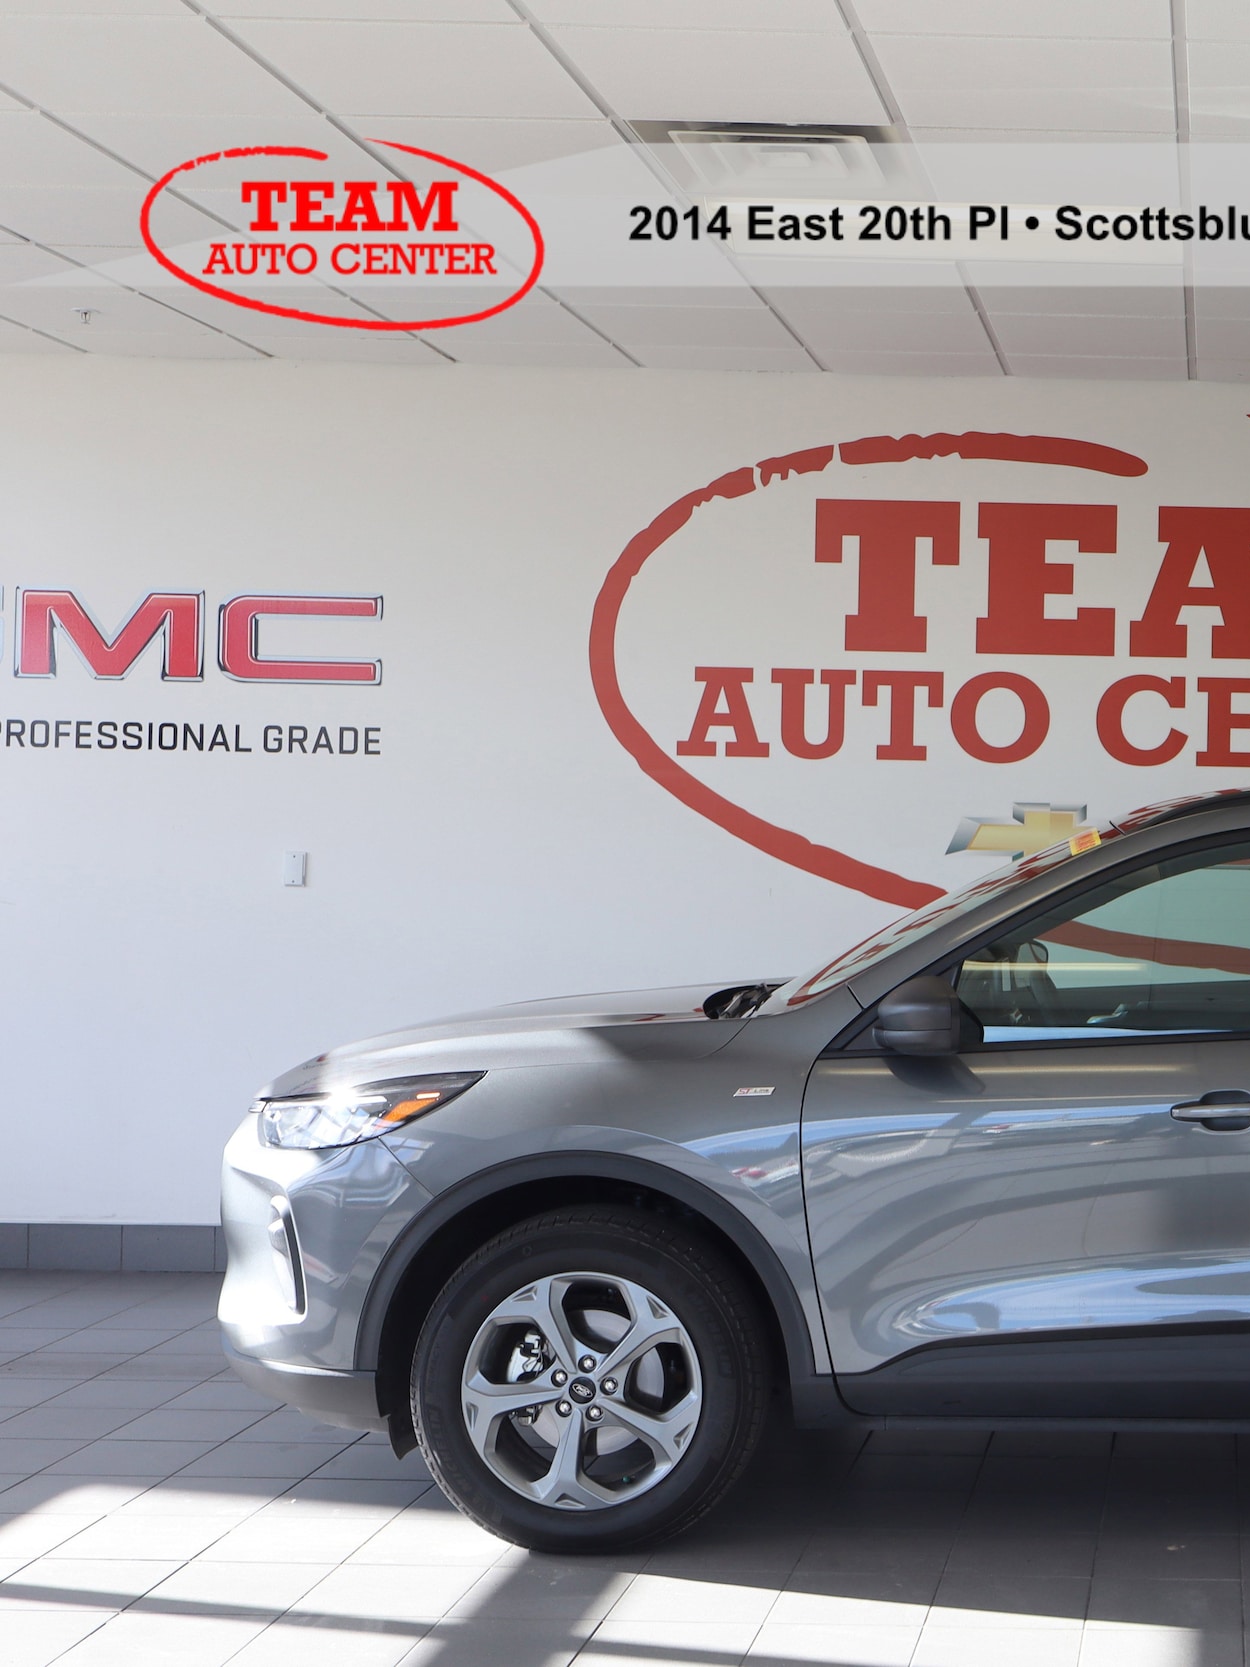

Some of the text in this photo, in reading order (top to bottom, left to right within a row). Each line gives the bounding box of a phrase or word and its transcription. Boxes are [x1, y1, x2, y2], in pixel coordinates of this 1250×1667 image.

[0, 584, 384, 687] MC
[0, 719, 382, 755] ROFESSIONAL GRADE
[675, 666, 1051, 765] AUTO
[425, 1406, 476, 1496] MICHELIN
